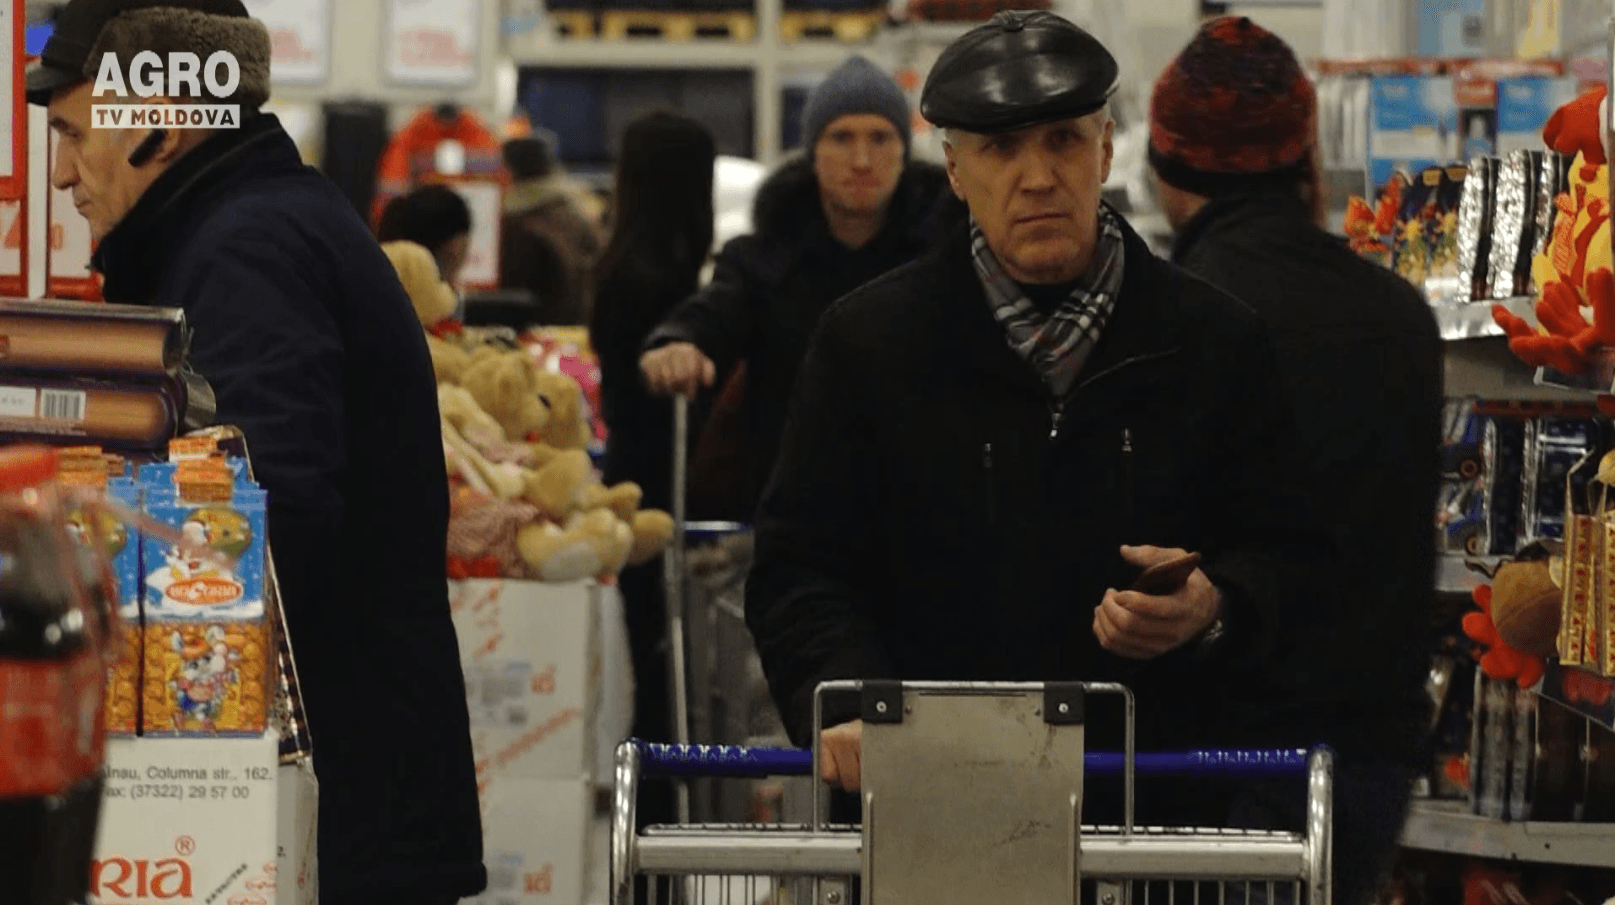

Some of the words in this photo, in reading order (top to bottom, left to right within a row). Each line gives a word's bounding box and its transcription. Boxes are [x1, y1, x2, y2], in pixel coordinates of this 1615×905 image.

[147, 765, 207, 780] Columna
[130, 784, 183, 801] (37322)
[188, 785, 207, 799] 29
[211, 785, 228, 799] 57
[232, 785, 250, 799] 00
